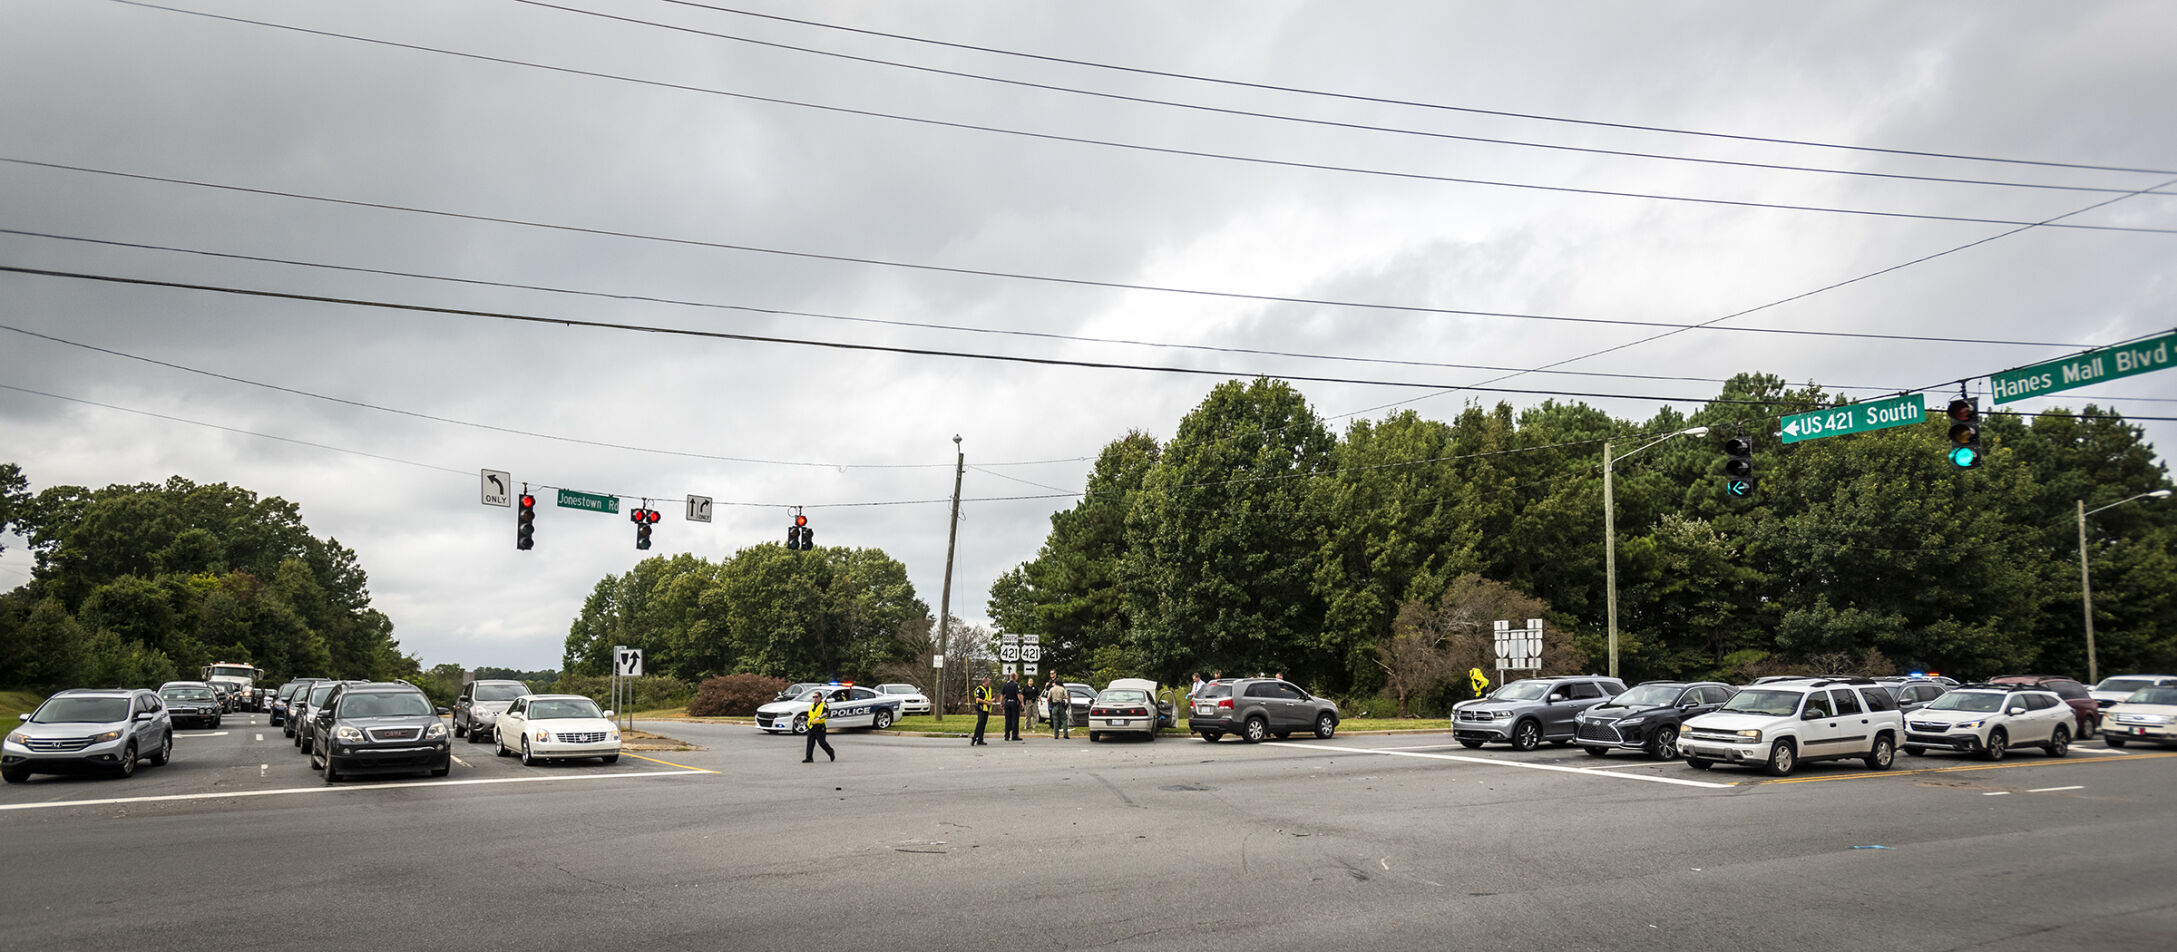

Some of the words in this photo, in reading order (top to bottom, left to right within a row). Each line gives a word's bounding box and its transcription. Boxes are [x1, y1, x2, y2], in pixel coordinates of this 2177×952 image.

[1993, 373, 2052, 399] Hanes
[2062, 357, 2104, 384] Mall
[2116, 342, 2168, 372] Blvd
[1866, 401, 1918, 425] South
[486, 495, 506, 504] ONLY
[559, 493, 602, 509] Jonestown
[608, 501, 619, 512] Rd
[1002, 647, 1018, 659] 421
[1023, 648, 1039, 659] 421
[830, 706, 871, 718] POLICE
